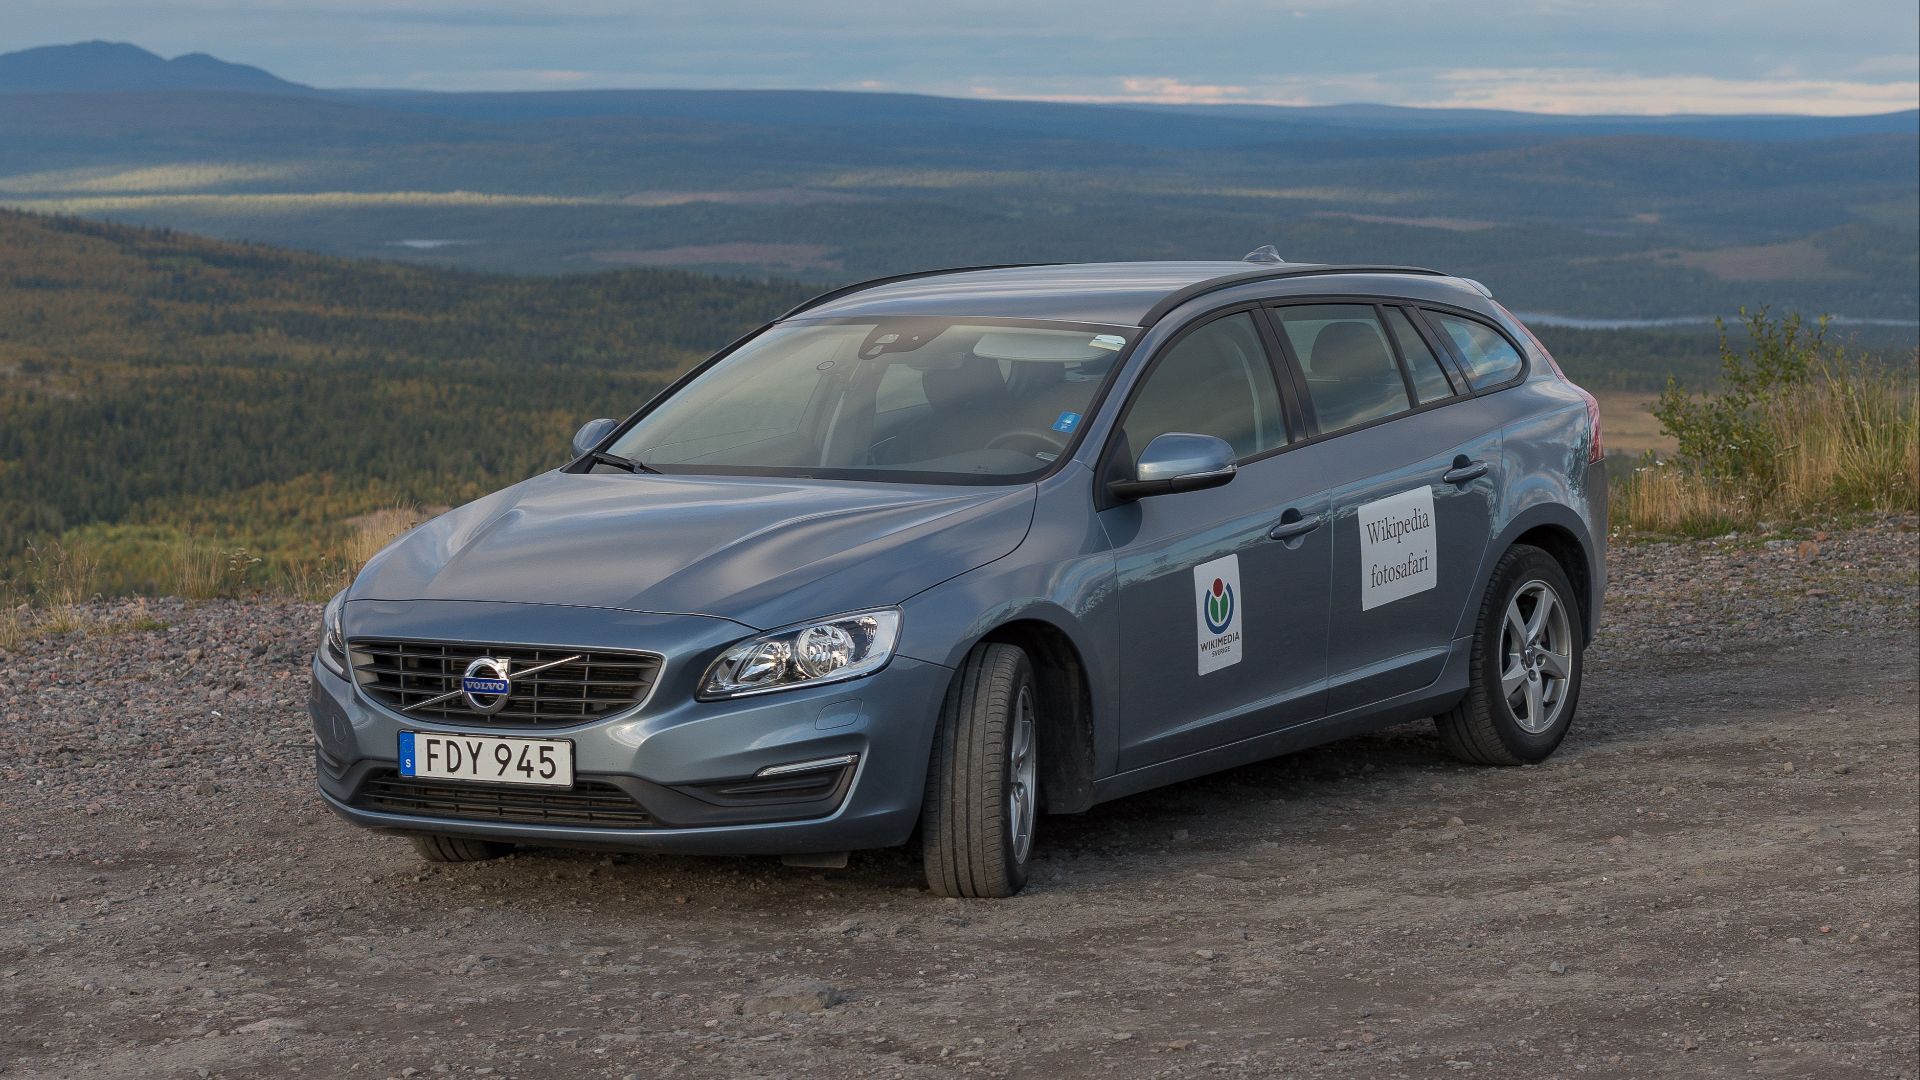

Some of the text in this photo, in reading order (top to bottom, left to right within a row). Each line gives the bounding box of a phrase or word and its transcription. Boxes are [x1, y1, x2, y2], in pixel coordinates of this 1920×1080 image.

[1366, 508, 1430, 545] Wikipedia
[1370, 549, 1429, 588] fotosafari
[1200, 631, 1240, 653] WIKIMEDIA
[1211, 645, 1231, 658] SVERIGE
[465, 680, 505, 691] VOLVO
[405, 758, 412, 768] S
[426, 738, 557, 779] FDY 945
